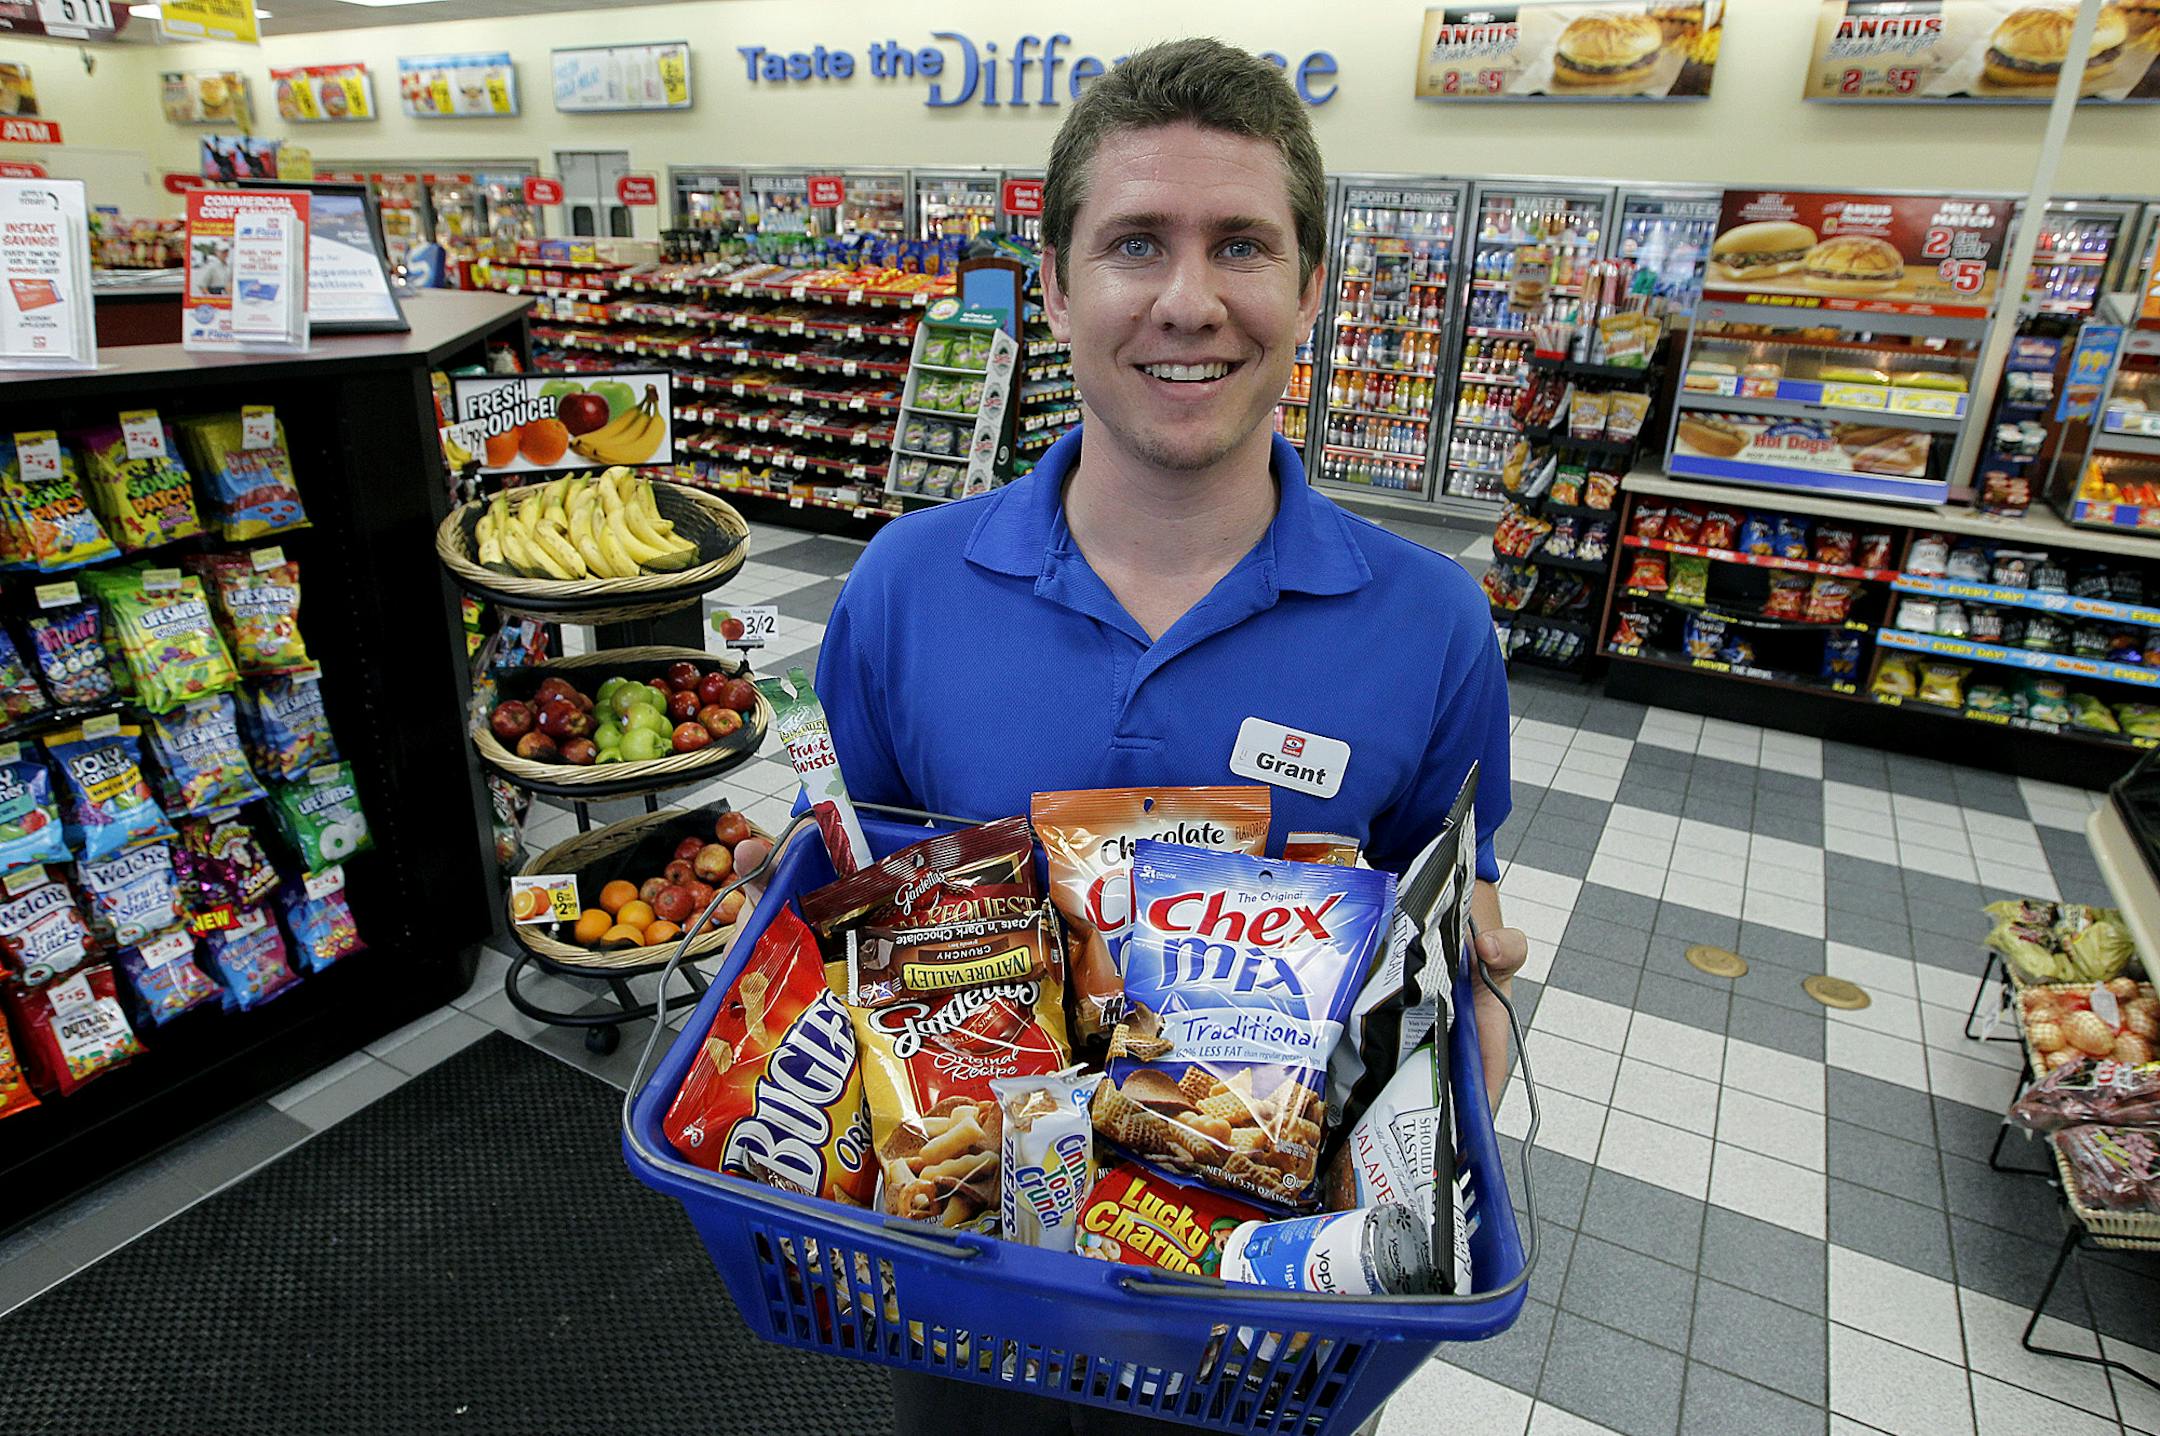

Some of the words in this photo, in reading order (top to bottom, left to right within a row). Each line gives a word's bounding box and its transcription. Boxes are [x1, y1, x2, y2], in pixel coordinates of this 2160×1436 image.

[1436, 24, 1518, 46] ANGUS
[1836, 15, 1942, 39] ANGUS
[738, 45, 854, 81] Taste
[869, 41, 945, 77] the
[925, 31, 1339, 107] Diffee
[1841, 68, 1863, 94] 2
[3, 122, 50, 142] ATM
[203, 195, 292, 207] COMMERCIAL
[1350, 190, 1400, 203] SPORTS
[1403, 192, 1455, 207] DRINKS
[1516, 198, 1566, 212] WATER
[1663, 200, 1719, 218] WATER
[200, 206, 235, 218] COST
[1932, 214, 1996, 229] MATCH
[5, 223, 56, 234] INSTANT
[1923, 228, 1953, 257] 2
[466, 379, 530, 420] FRESH
[477, 395, 556, 441] RODUCE!
[1754, 433, 1782, 449] Hot
[1787, 434, 1839, 455] Dogs!
[126, 471, 187, 497] SOUR
[131, 483, 193, 518] PATCH
[1949, 585, 1991, 598] EVERY
[1932, 642, 1974, 656] EVERY
[786, 738, 830, 760] Fruit
[72, 747, 120, 779] JOLLY
[792, 752, 837, 775] Twists
[1256, 752, 1327, 785] Grant
[1102, 821, 1225, 867] Chcolate
[93, 850, 168, 886] Welch's
[0, 887, 67, 929] Welch's
[556, 892, 564, 902] 6
[1238, 892, 1257, 904] The
[1260, 890, 1304, 903] Original
[192, 909, 230, 932] NEW
[1001, 918, 1029, 931] Oats
[1147, 890, 1348, 948] Chex
[895, 928, 953, 947] Chocolate
[954, 925, 986, 940] Dark
[936, 945, 992, 961] CRUNCHY
[908, 964, 965, 989] VALLEY
[968, 951, 1026, 983] NATURE
[1182, 1014, 1320, 1050] Traditional
[933, 1047, 1019, 1069] Original
[1199, 1046, 1222, 1057] LESS
[1223, 1046, 1243, 1057] FAT
[1244, 1050, 1258, 1058] than
[1259, 1051, 1281, 1061] regular
[943, 1065, 1018, 1082] Recipe
[1401, 1118, 1419, 1180] TASTE
[1420, 1117, 1434, 1176] SHOULD
[1205, 1164, 1222, 1177] NET
[1224, 1171, 1238, 1184] WT
[1355, 1123, 1397, 1209] JALAPE
[1003, 1136, 1017, 1236] TREATS
[1014, 1166, 1064, 1229] Crunch
[1044, 1165, 1076, 1214] Toast
[1119, 1176, 1210, 1257] Lucky
[1284, 1263, 1298, 1291] ligh
[1315, 1248, 1337, 1295] Yopl
